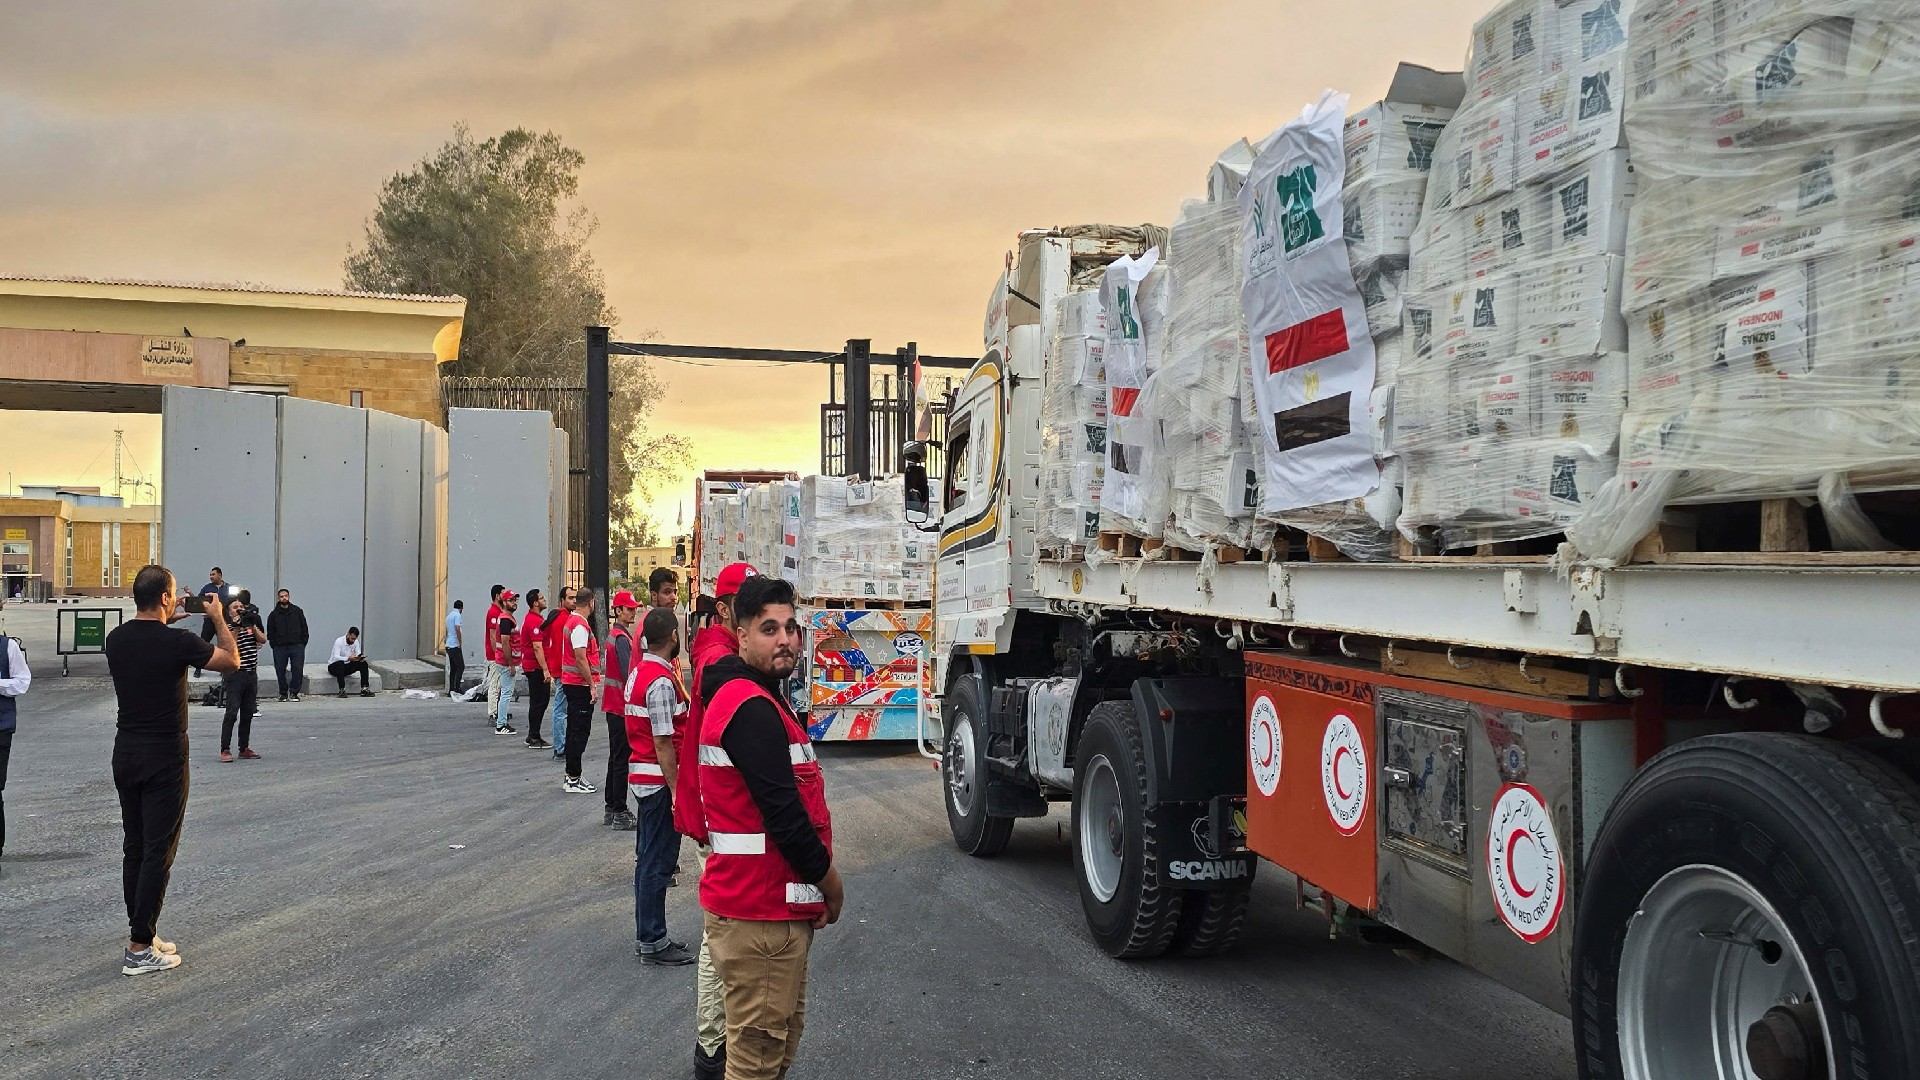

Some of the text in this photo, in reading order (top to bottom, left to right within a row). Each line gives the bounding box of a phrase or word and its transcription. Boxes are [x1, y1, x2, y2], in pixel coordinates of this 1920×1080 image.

[1808, 226, 1822, 238] AID
[1738, 309, 1783, 327] INDONESIA
[1741, 331, 1776, 346] BAZNAS
[1528, 819, 1555, 861] الهلال
[1169, 860, 1248, 881] SCANIA
[1494, 857, 1554, 924] EGYPTIAN RED CRESCENT
